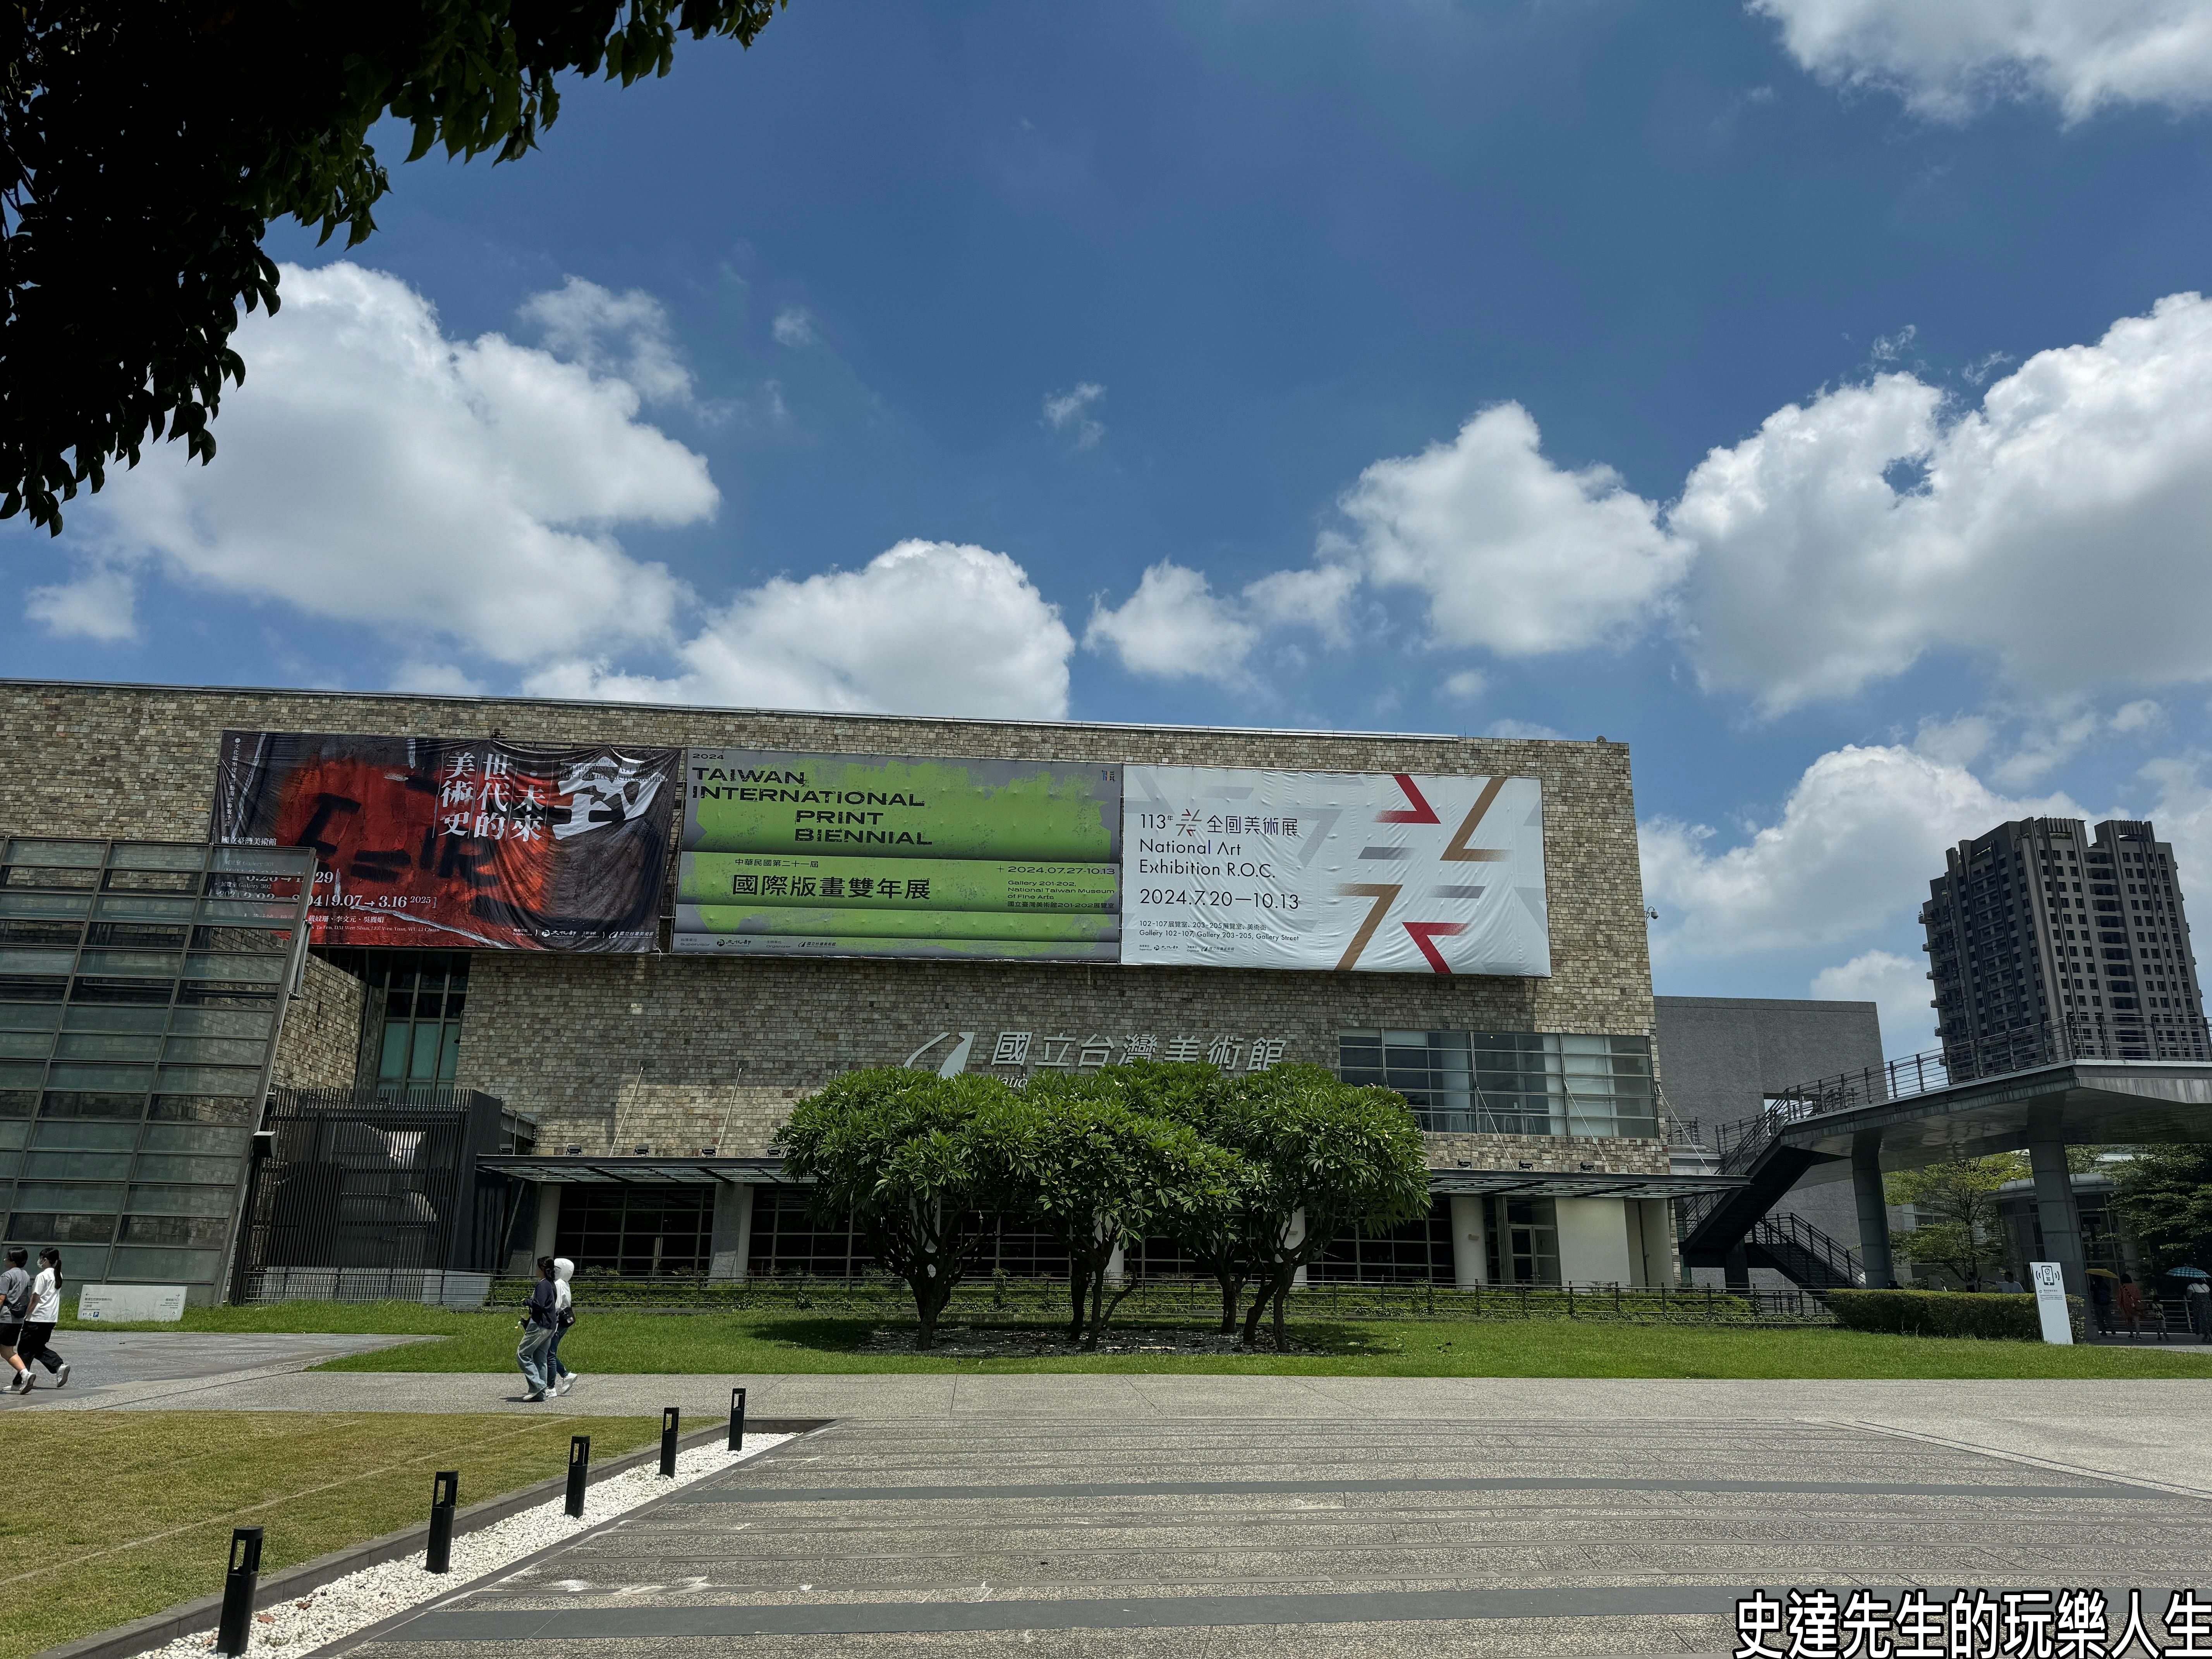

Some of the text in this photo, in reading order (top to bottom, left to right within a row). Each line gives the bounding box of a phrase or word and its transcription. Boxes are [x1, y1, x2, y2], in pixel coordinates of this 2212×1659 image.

[692, 767, 805, 785] TAIWAN
[438, 752, 475, 836] 美術史
[474, 753, 513, 840] 世代的
[692, 785, 925, 807] INTERNATIONAL
[510, 785, 545, 842] 未來
[795, 810, 884, 825] PRINT
[221, 836, 277, 846] 國立臺灣美術館
[795, 828, 933, 845] BIENNIAL
[1140, 838, 1241, 855] National Art
[735, 858, 819, 868] 中華民國第二十一屆
[1007, 866, 1115, 875] 2024.07.27-10.13
[1139, 858, 1276, 878] Exhibition R.O.C.
[732, 874, 931, 900] 國際版畫雙年展
[331, 894, 363, 907] 9.07
[378, 895, 407, 908] 3.16
[410, 896, 431, 904] 2025
[1007, 901, 1115, 909] 國立臺灣美術館201-202展覽室
[1165, 930, 1195, 938] 102-107,
[1197, 931, 1220, 939] Gallery
[1222, 932, 1254, 940] 203-205,
[1256, 933, 1279, 941] Gallery
[991, 1031, 1287, 1071] 國立台灣美術館
